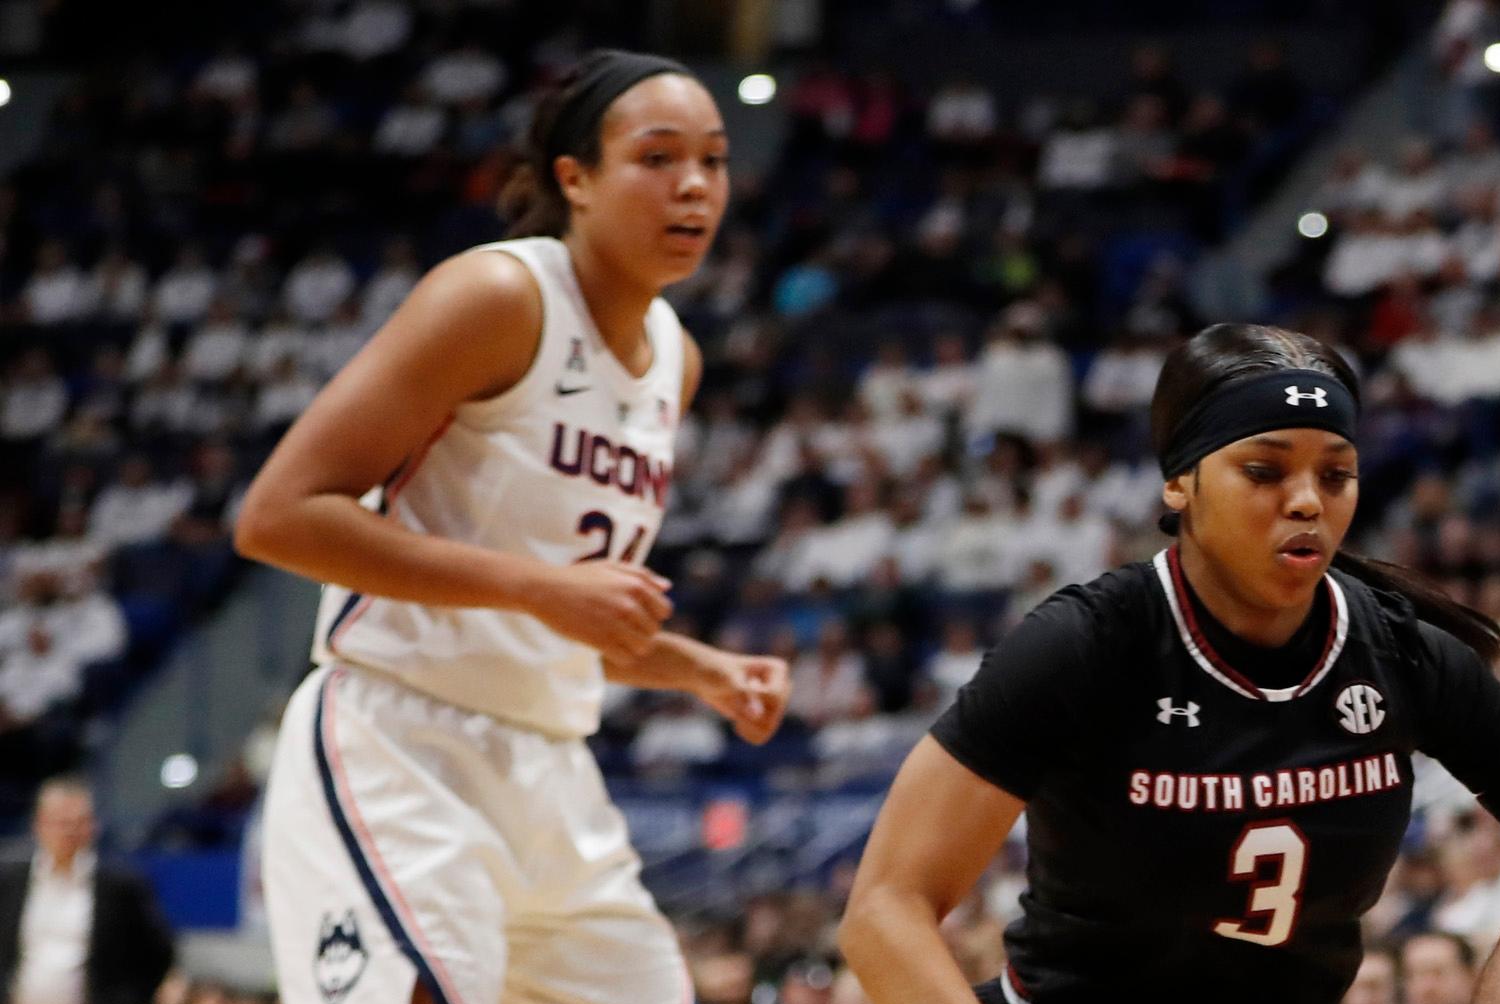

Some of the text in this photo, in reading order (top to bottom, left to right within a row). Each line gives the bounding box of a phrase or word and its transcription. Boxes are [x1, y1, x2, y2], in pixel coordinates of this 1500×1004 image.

[548, 421, 670, 509] UCON
[1336, 684, 1386, 734] SEC
[1129, 752, 1401, 811] SOUTH CAROLINA
[1211, 817, 1310, 946] 3
